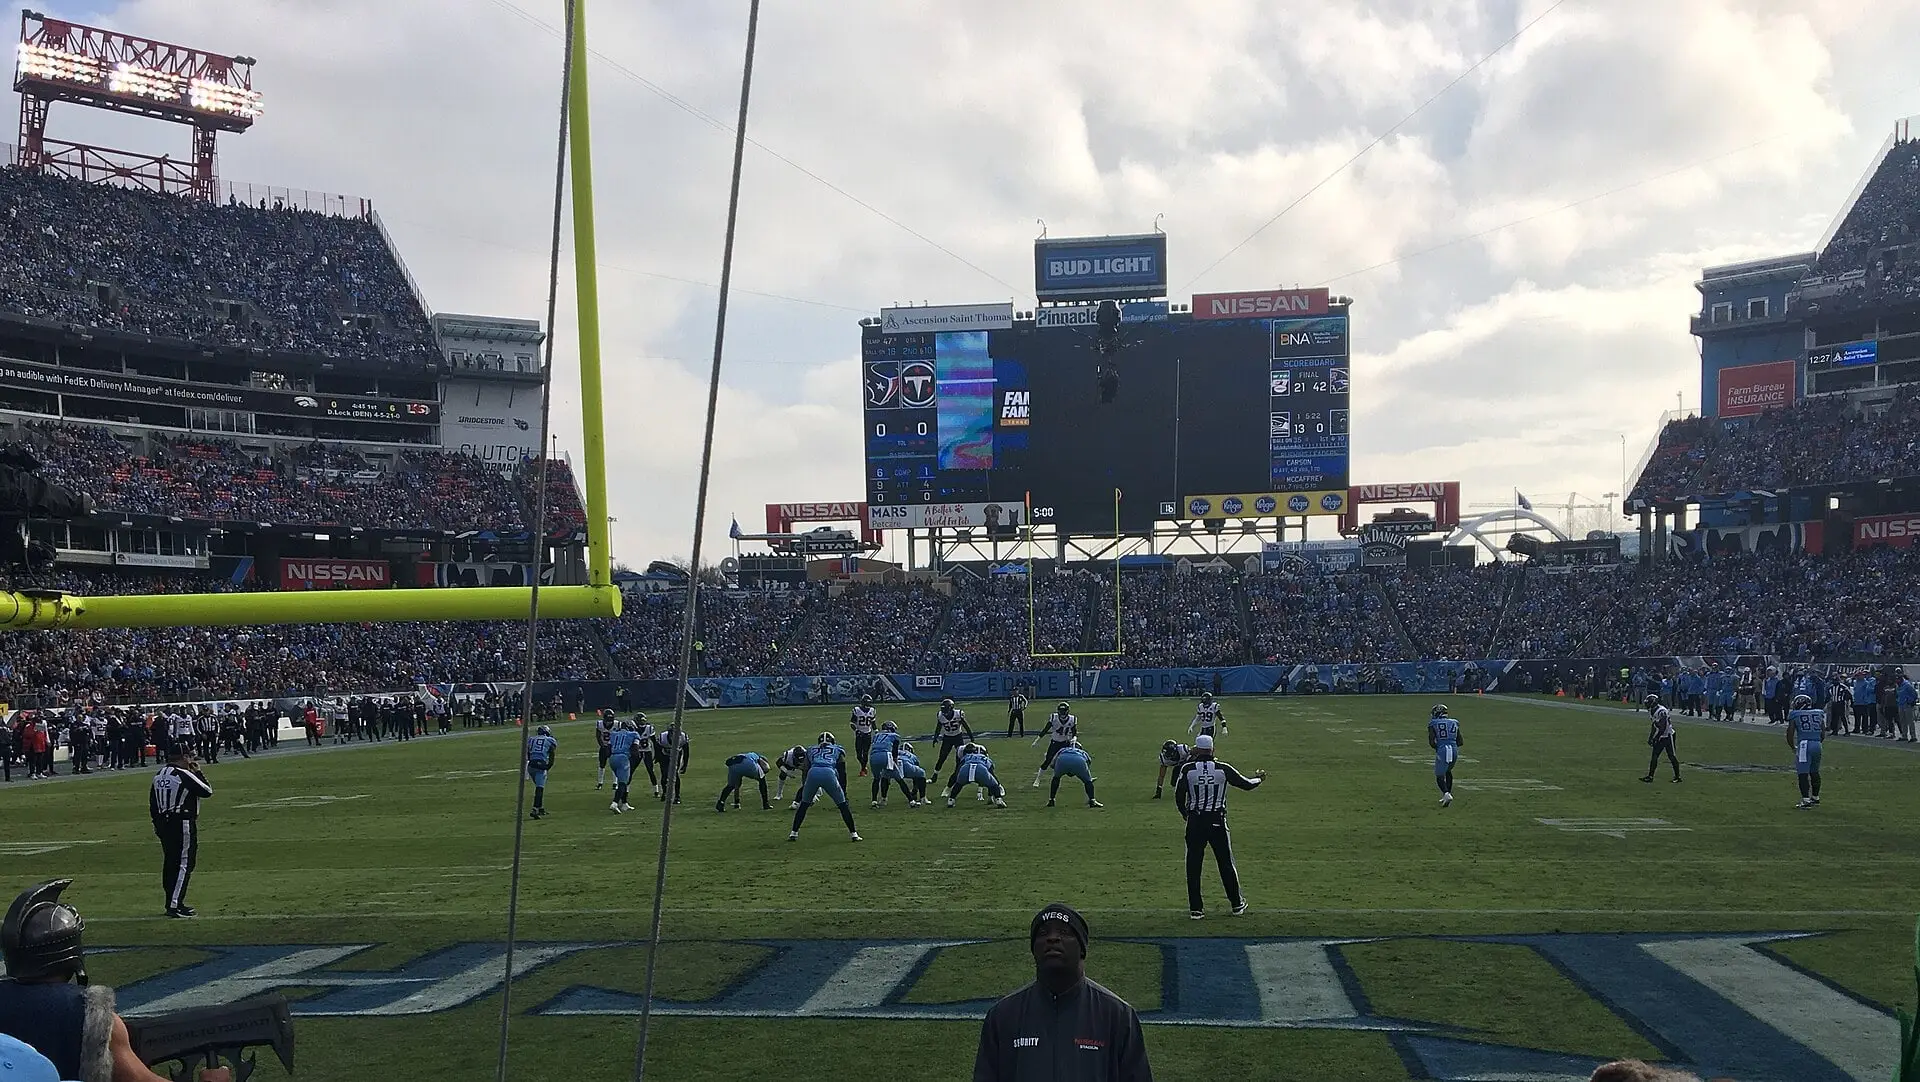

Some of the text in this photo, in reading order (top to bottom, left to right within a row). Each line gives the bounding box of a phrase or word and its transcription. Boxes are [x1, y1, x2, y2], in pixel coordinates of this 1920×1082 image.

[1050, 256, 1151, 276] BUD LIGHT
[1211, 295, 1309, 315] NISSAN
[902, 311, 1011, 325] Ascension Saint Thomas
[1280, 333, 1310, 346] BNA
[1283, 359, 1336, 368] SCOREBOARD
[1298, 371, 1320, 379] FINAL
[5, 368, 15, 377] an
[17, 370, 45, 381] audible
[45, 373, 63, 384] with
[64, 375, 89, 387] FedEx
[90, 378, 123, 392] Delivery
[164, 388, 173, 396] at
[1294, 382, 1305, 393] 21
[1312, 381, 1327, 392] 42
[1728, 383, 1785, 396] Farm Bureau
[1727, 391, 1785, 406] INSURANCE
[331, 400, 337, 408] 0
[389, 404, 396, 412] 6
[458, 415, 505, 425] BRIDGESTONE
[876, 422, 928, 437] 0 0
[1294, 423, 1324, 434] 13 0
[460, 443, 530, 461] CLUTCH
[876, 468, 884, 477] 6
[924, 467, 929, 476] 1
[877, 481, 884, 490] 9
[923, 480, 930, 488] 4
[1286, 475, 1324, 483] MCCAFFREY
[1360, 482, 1444, 499] NISSAN
[877, 493, 884, 502] 0
[923, 492, 931, 501] 0
[1190, 502, 1210, 514] Kroger
[1222, 501, 1242, 513] Kroger
[1256, 500, 1276, 513] Kroger
[1289, 499, 1309, 511] Kroger
[1322, 497, 1342, 510] Kroger
[780, 503, 859, 517] NISSAN
[871, 507, 907, 518] MARS
[1033, 507, 1054, 517] 5:00
[872, 520, 902, 528] Petcare
[1384, 523, 1433, 531] TITAN
[809, 543, 855, 551] TITAN
[287, 563, 384, 580] NISSAN
[988, 676, 1058, 693] EDIE
[859, 715, 872, 727] 26
[1800, 714, 1822, 732] 85
[1437, 722, 1457, 739] 84
[614, 733, 628, 751] 11
[812, 748, 835, 763] 22
[157, 779, 171, 789] 102
[1198, 776, 1215, 784] 52
[1042, 911, 1070, 923] WESS
[1013, 1037, 1040, 1048] SEURITY
